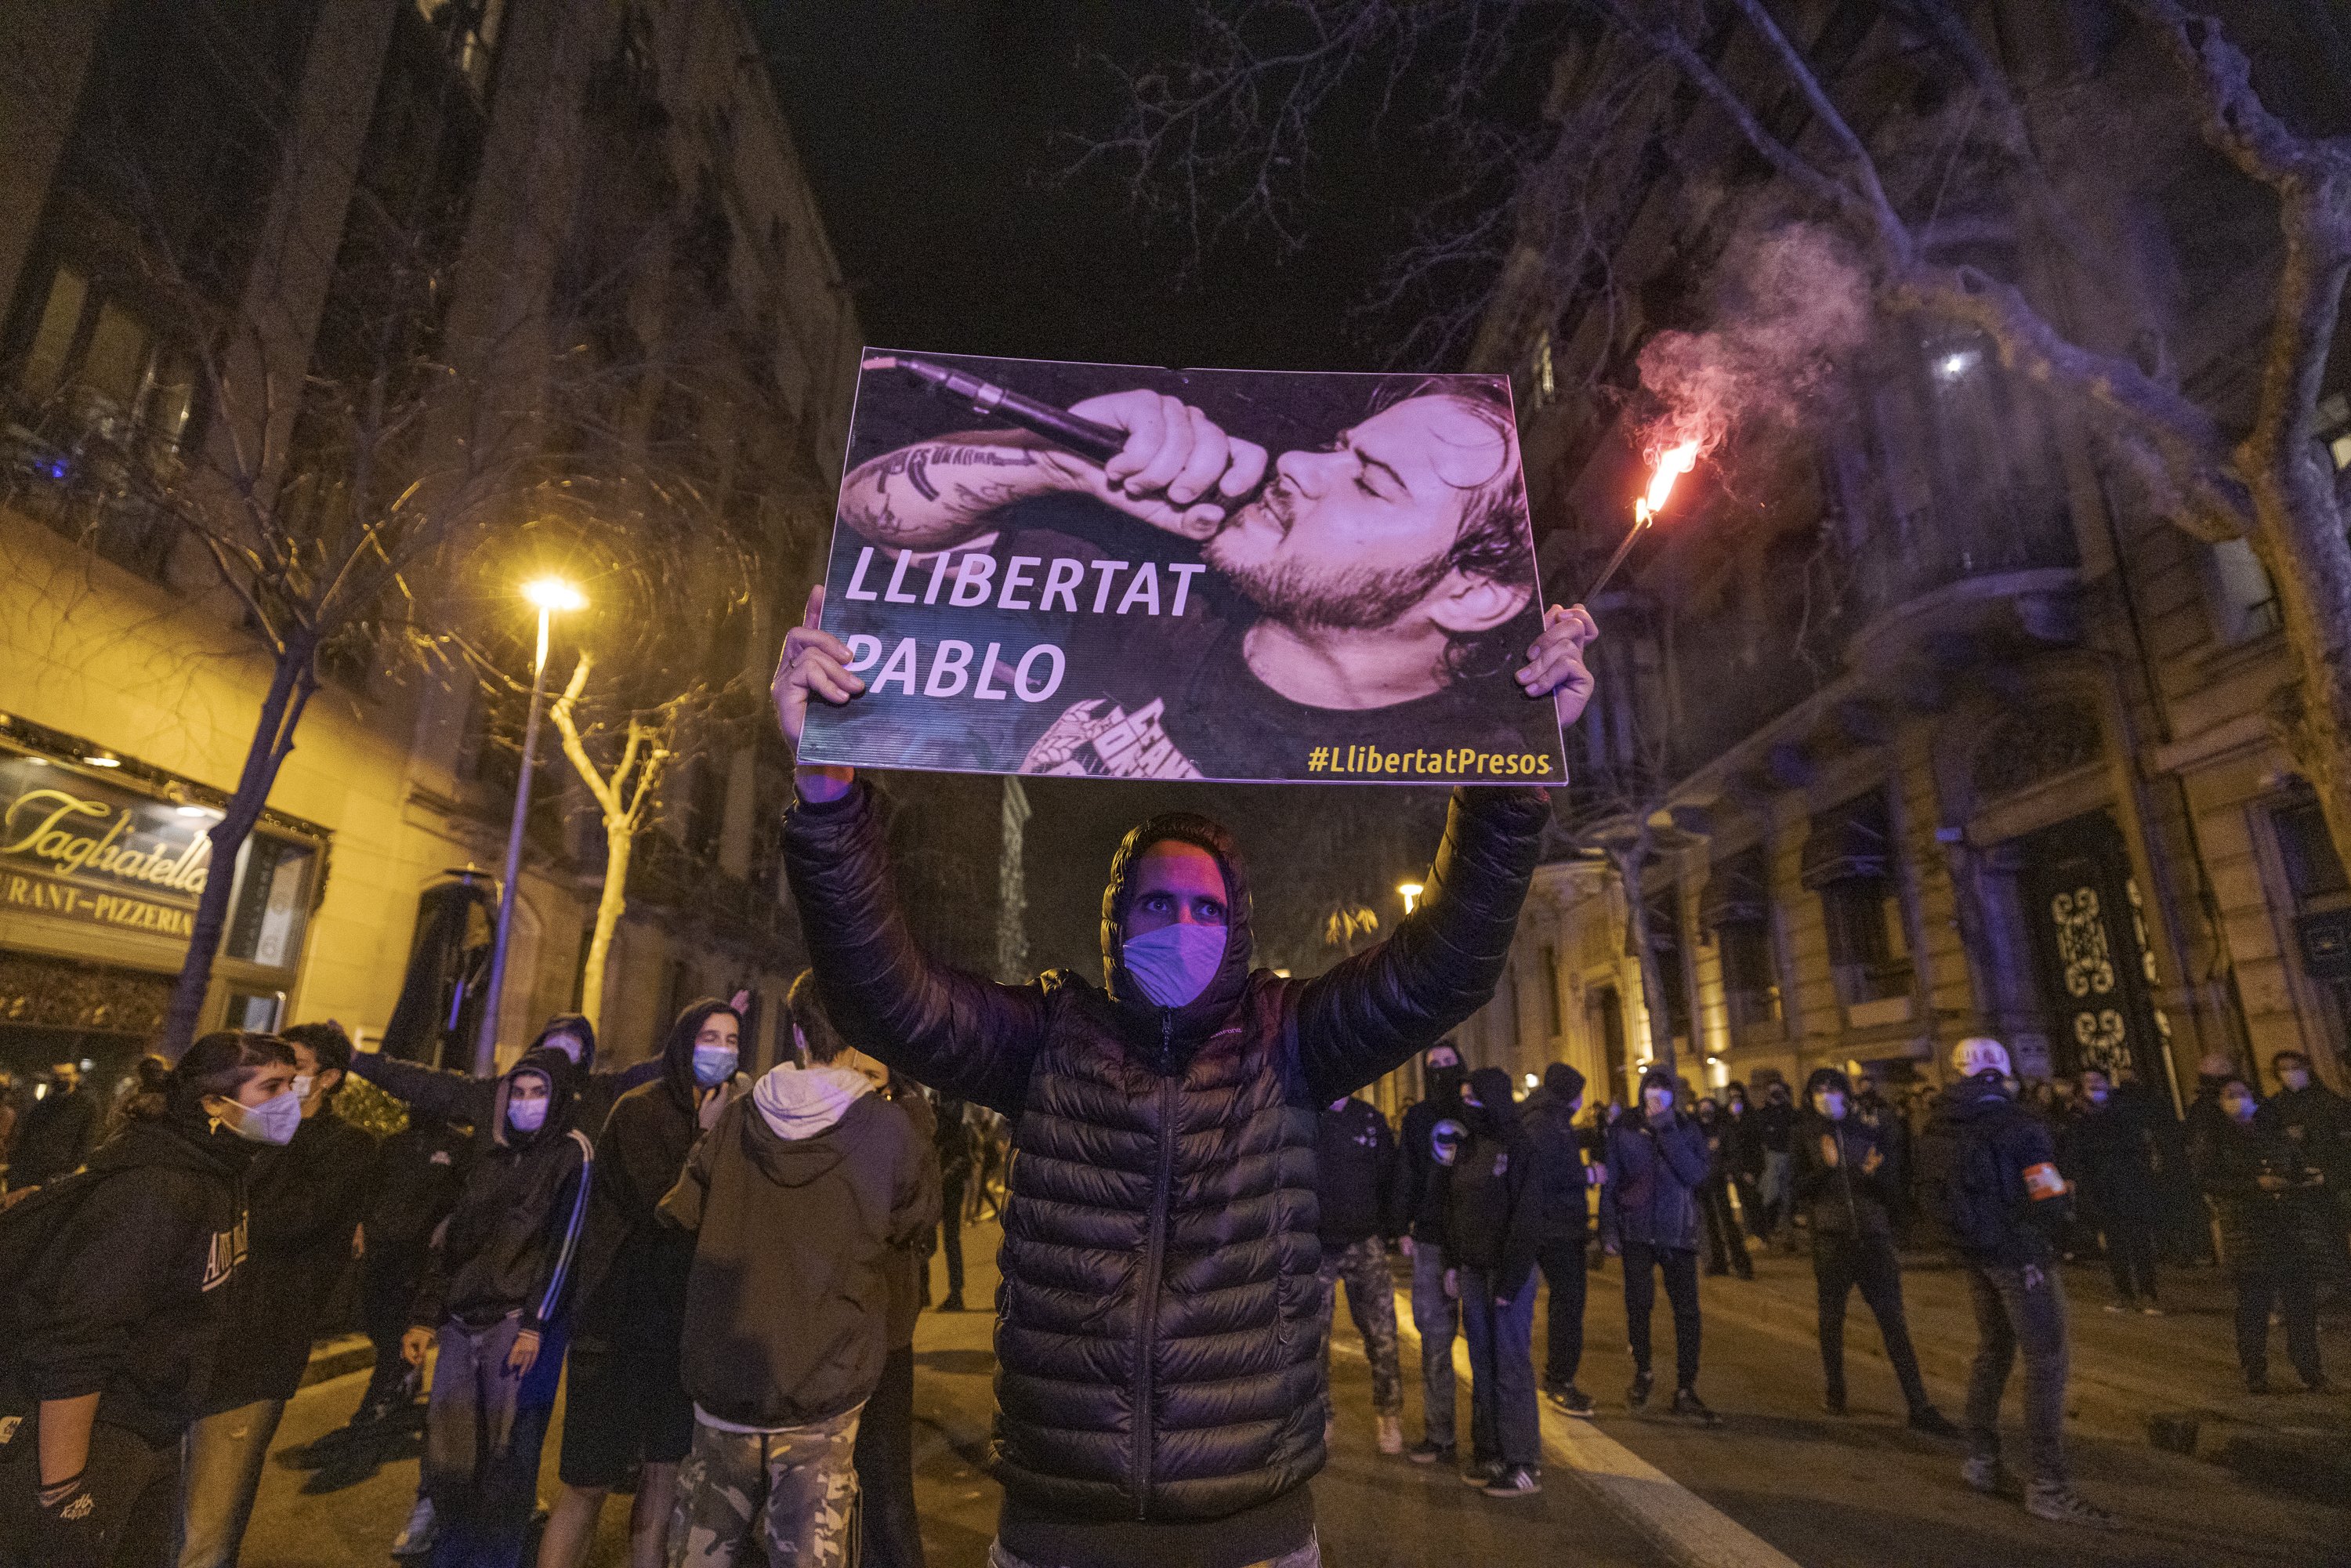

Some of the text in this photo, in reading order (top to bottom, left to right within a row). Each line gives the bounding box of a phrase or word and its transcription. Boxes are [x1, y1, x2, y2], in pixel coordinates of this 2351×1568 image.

[845, 546, 1207, 617] LLIBERTAT
[843, 634, 1067, 703] PABLO
[1307, 744, 1551, 776] #LlibertatPresos
[0, 789, 212, 894] Tagliatella
